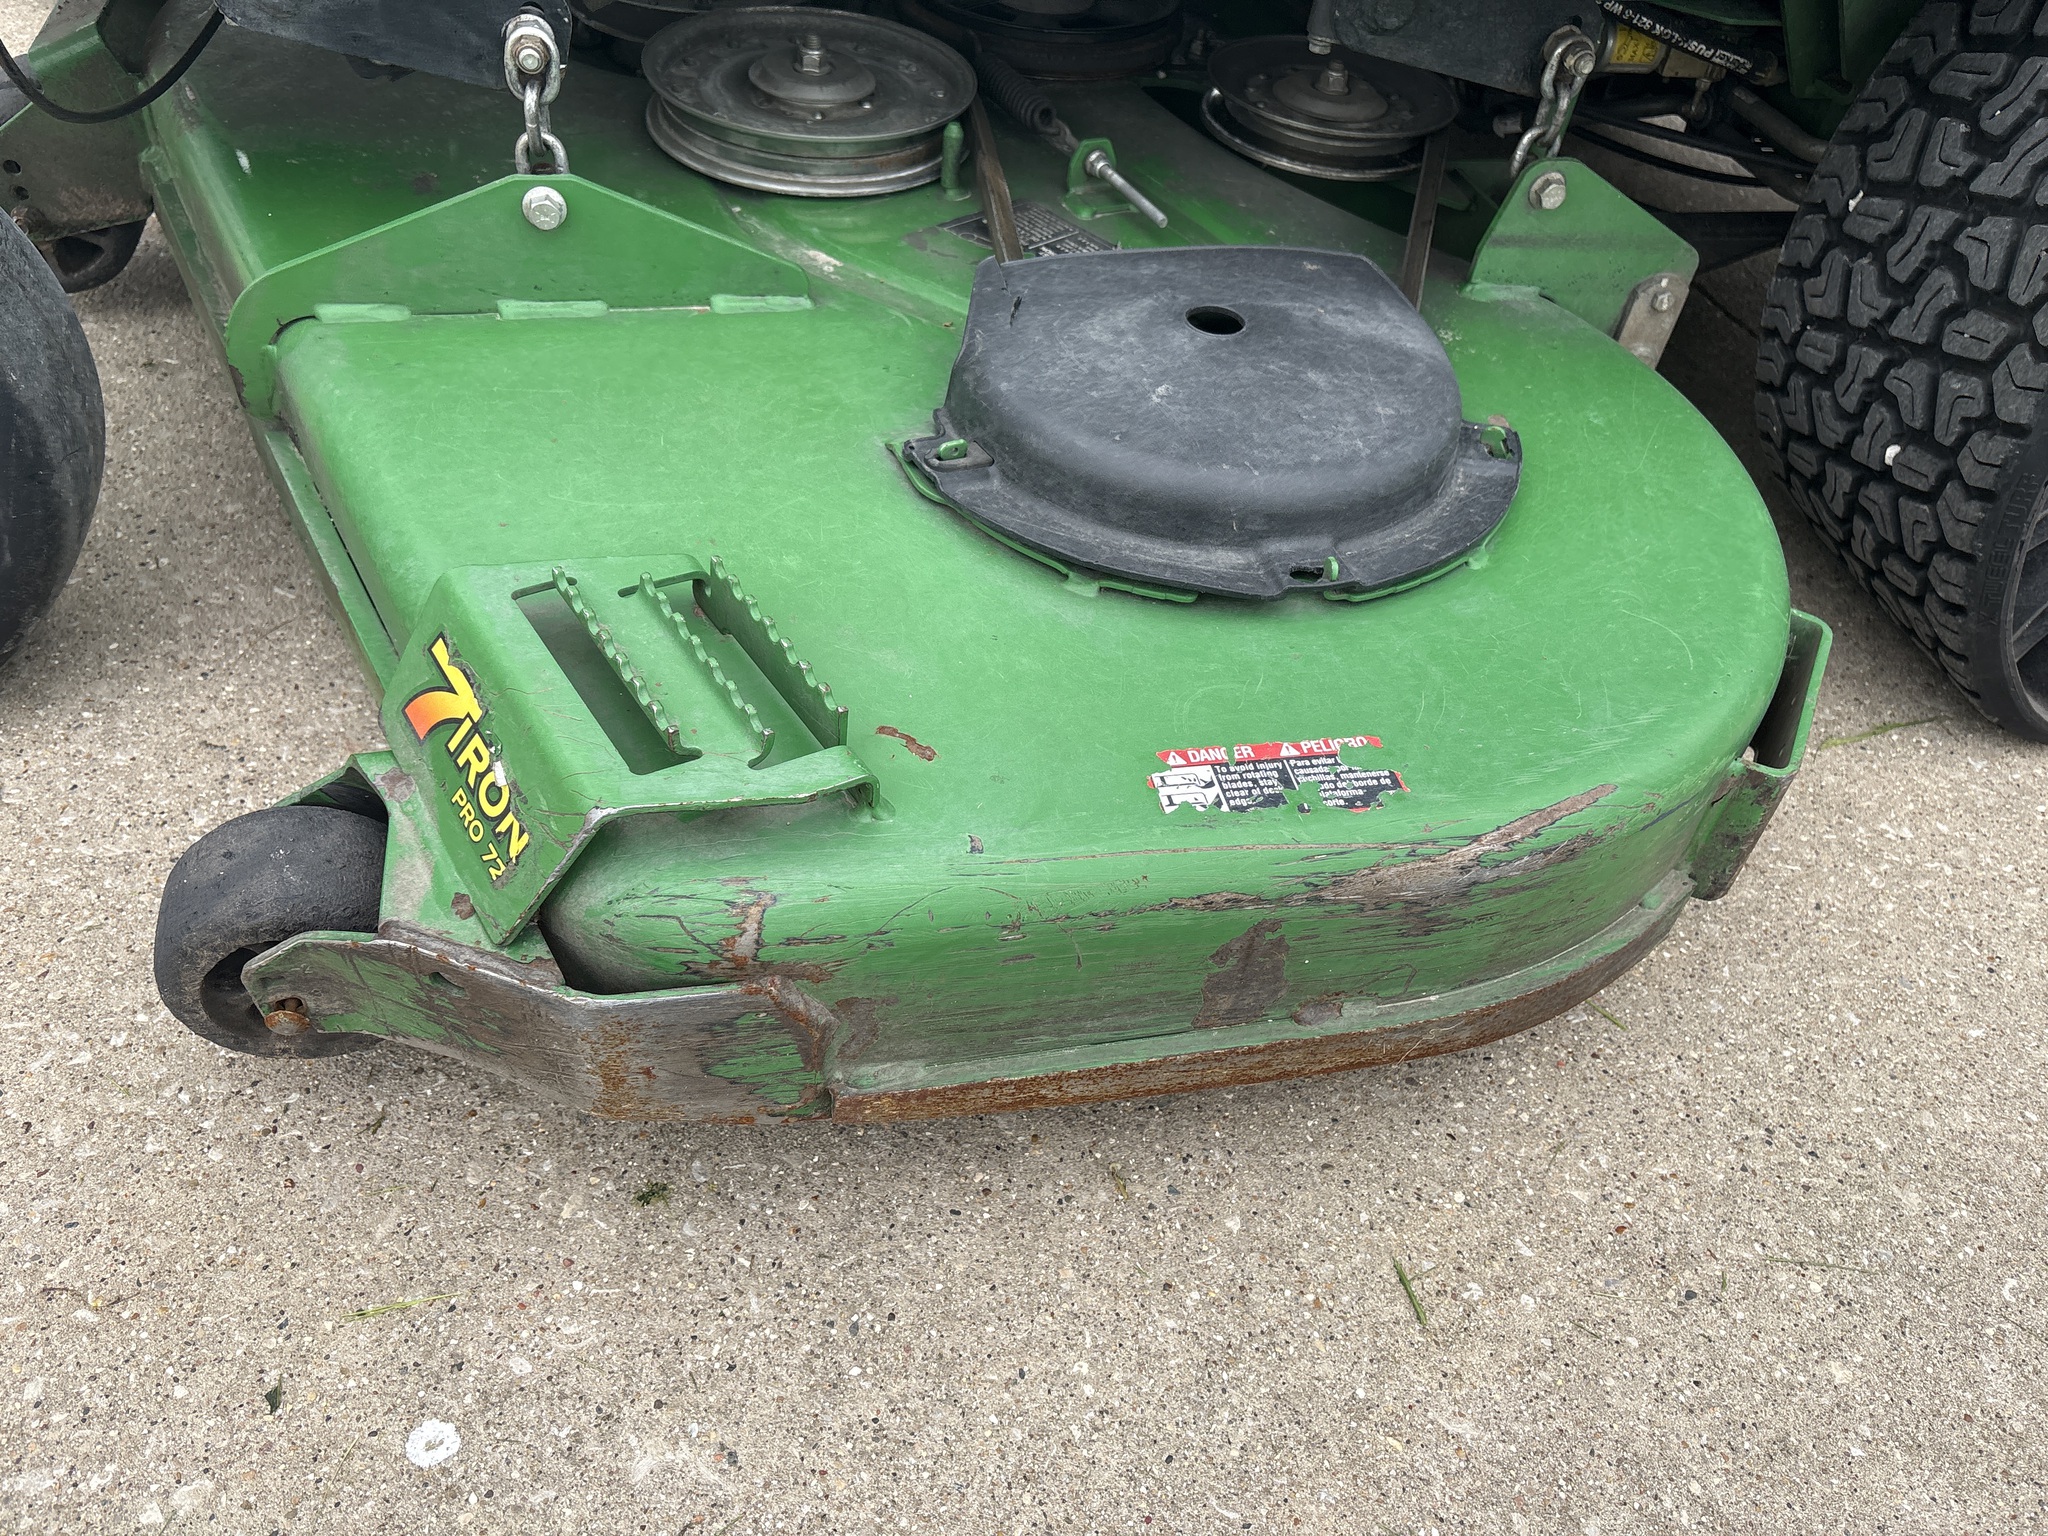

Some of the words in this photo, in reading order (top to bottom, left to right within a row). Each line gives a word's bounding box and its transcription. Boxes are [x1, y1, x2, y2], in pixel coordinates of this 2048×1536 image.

[1214, 765, 1227, 773] To
[1229, 762, 1254, 772] avoid
[1256, 760, 1282, 771] injury
[1289, 758, 1310, 768] Para
[1311, 756, 1335, 766] evitar
[1218, 773, 1240, 782] from
[1242, 770, 1279, 779] rotating
[1340, 769, 1390, 780] mantenerse
[1221, 780, 1257, 790] blades,
[1258, 778, 1278, 788] stay
[1353, 777, 1379, 787] borde
[1379, 777, 1392, 786] de
[1225, 788, 1249, 798] clear
[1251, 787, 1261, 796] of
[451, 787, 484, 843] PRO
[480, 842, 507, 881] 72
